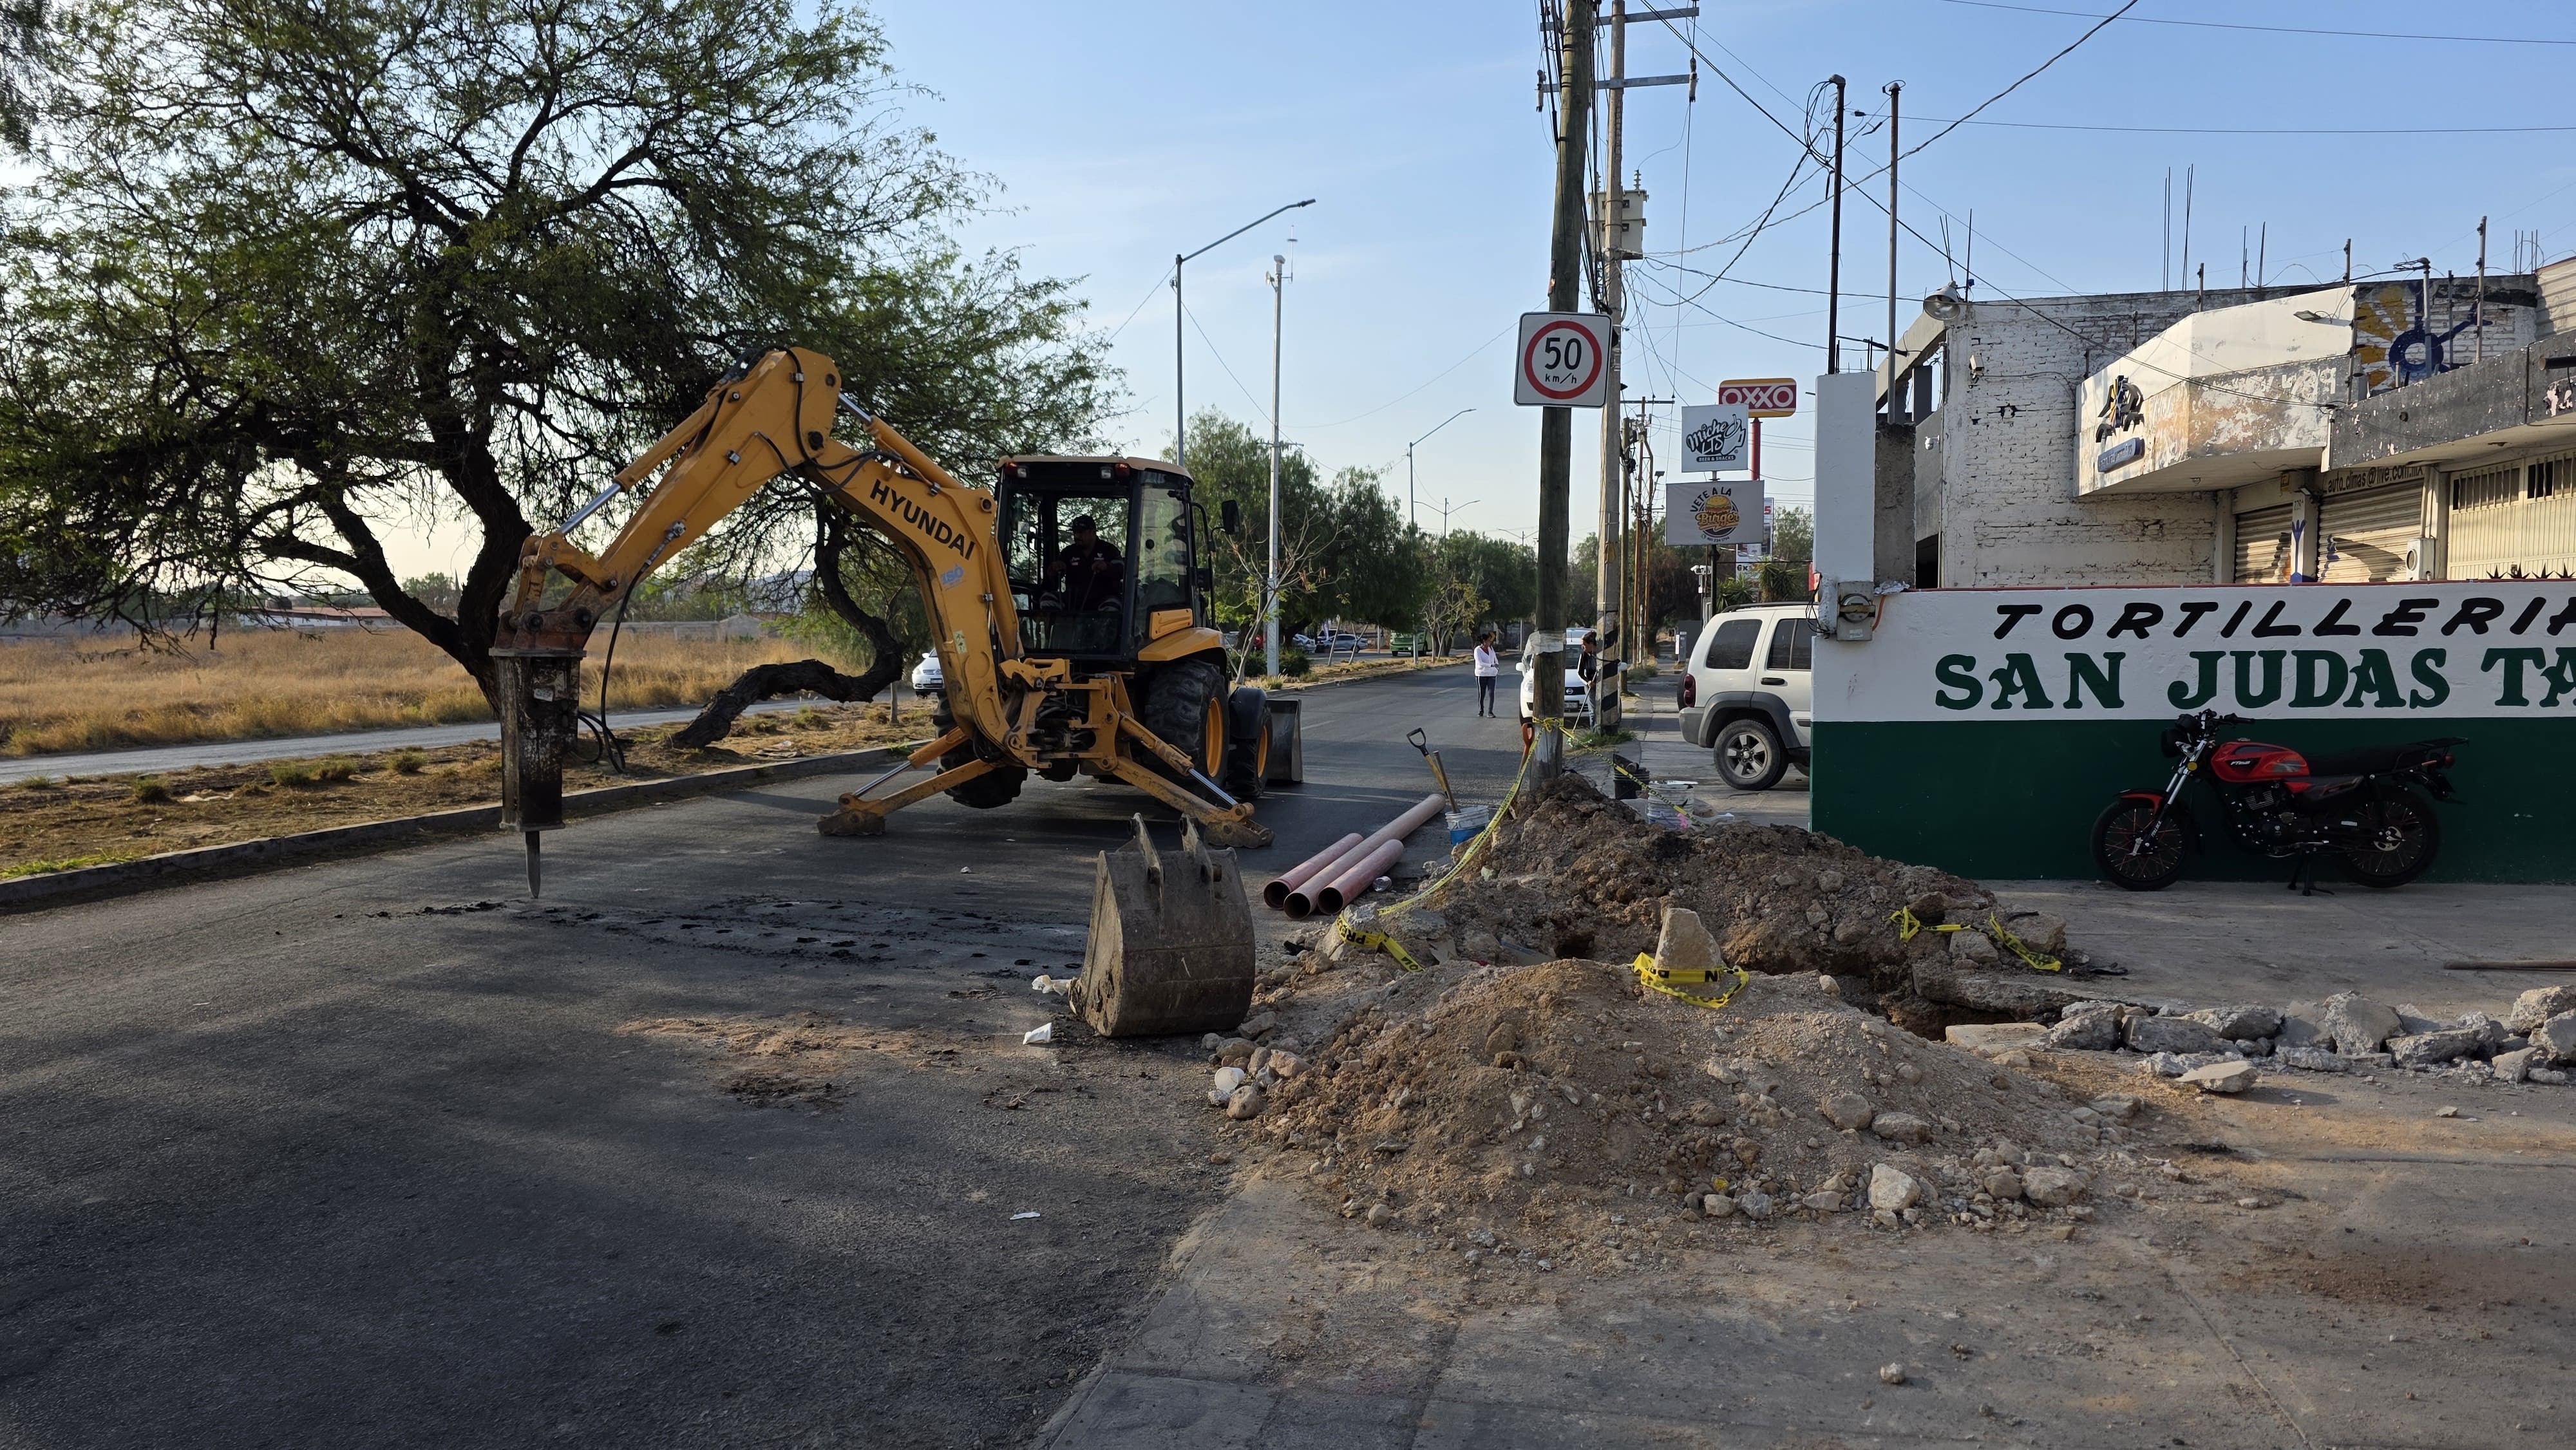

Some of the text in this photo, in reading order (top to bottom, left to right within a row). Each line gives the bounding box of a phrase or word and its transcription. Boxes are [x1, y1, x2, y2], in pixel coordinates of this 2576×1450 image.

[1545, 337, 1582, 370] 50
[1546, 372, 1577, 384] km/h
[1721, 385, 1794, 408] OXXO
[1690, 486, 1732, 512] VETE A LA
[870, 478, 975, 560] HYUNDAI
[1695, 512, 1739, 527] Burger
[1935, 652, 2126, 710] SAN
[2167, 648, 2450, 709] JUDAS
